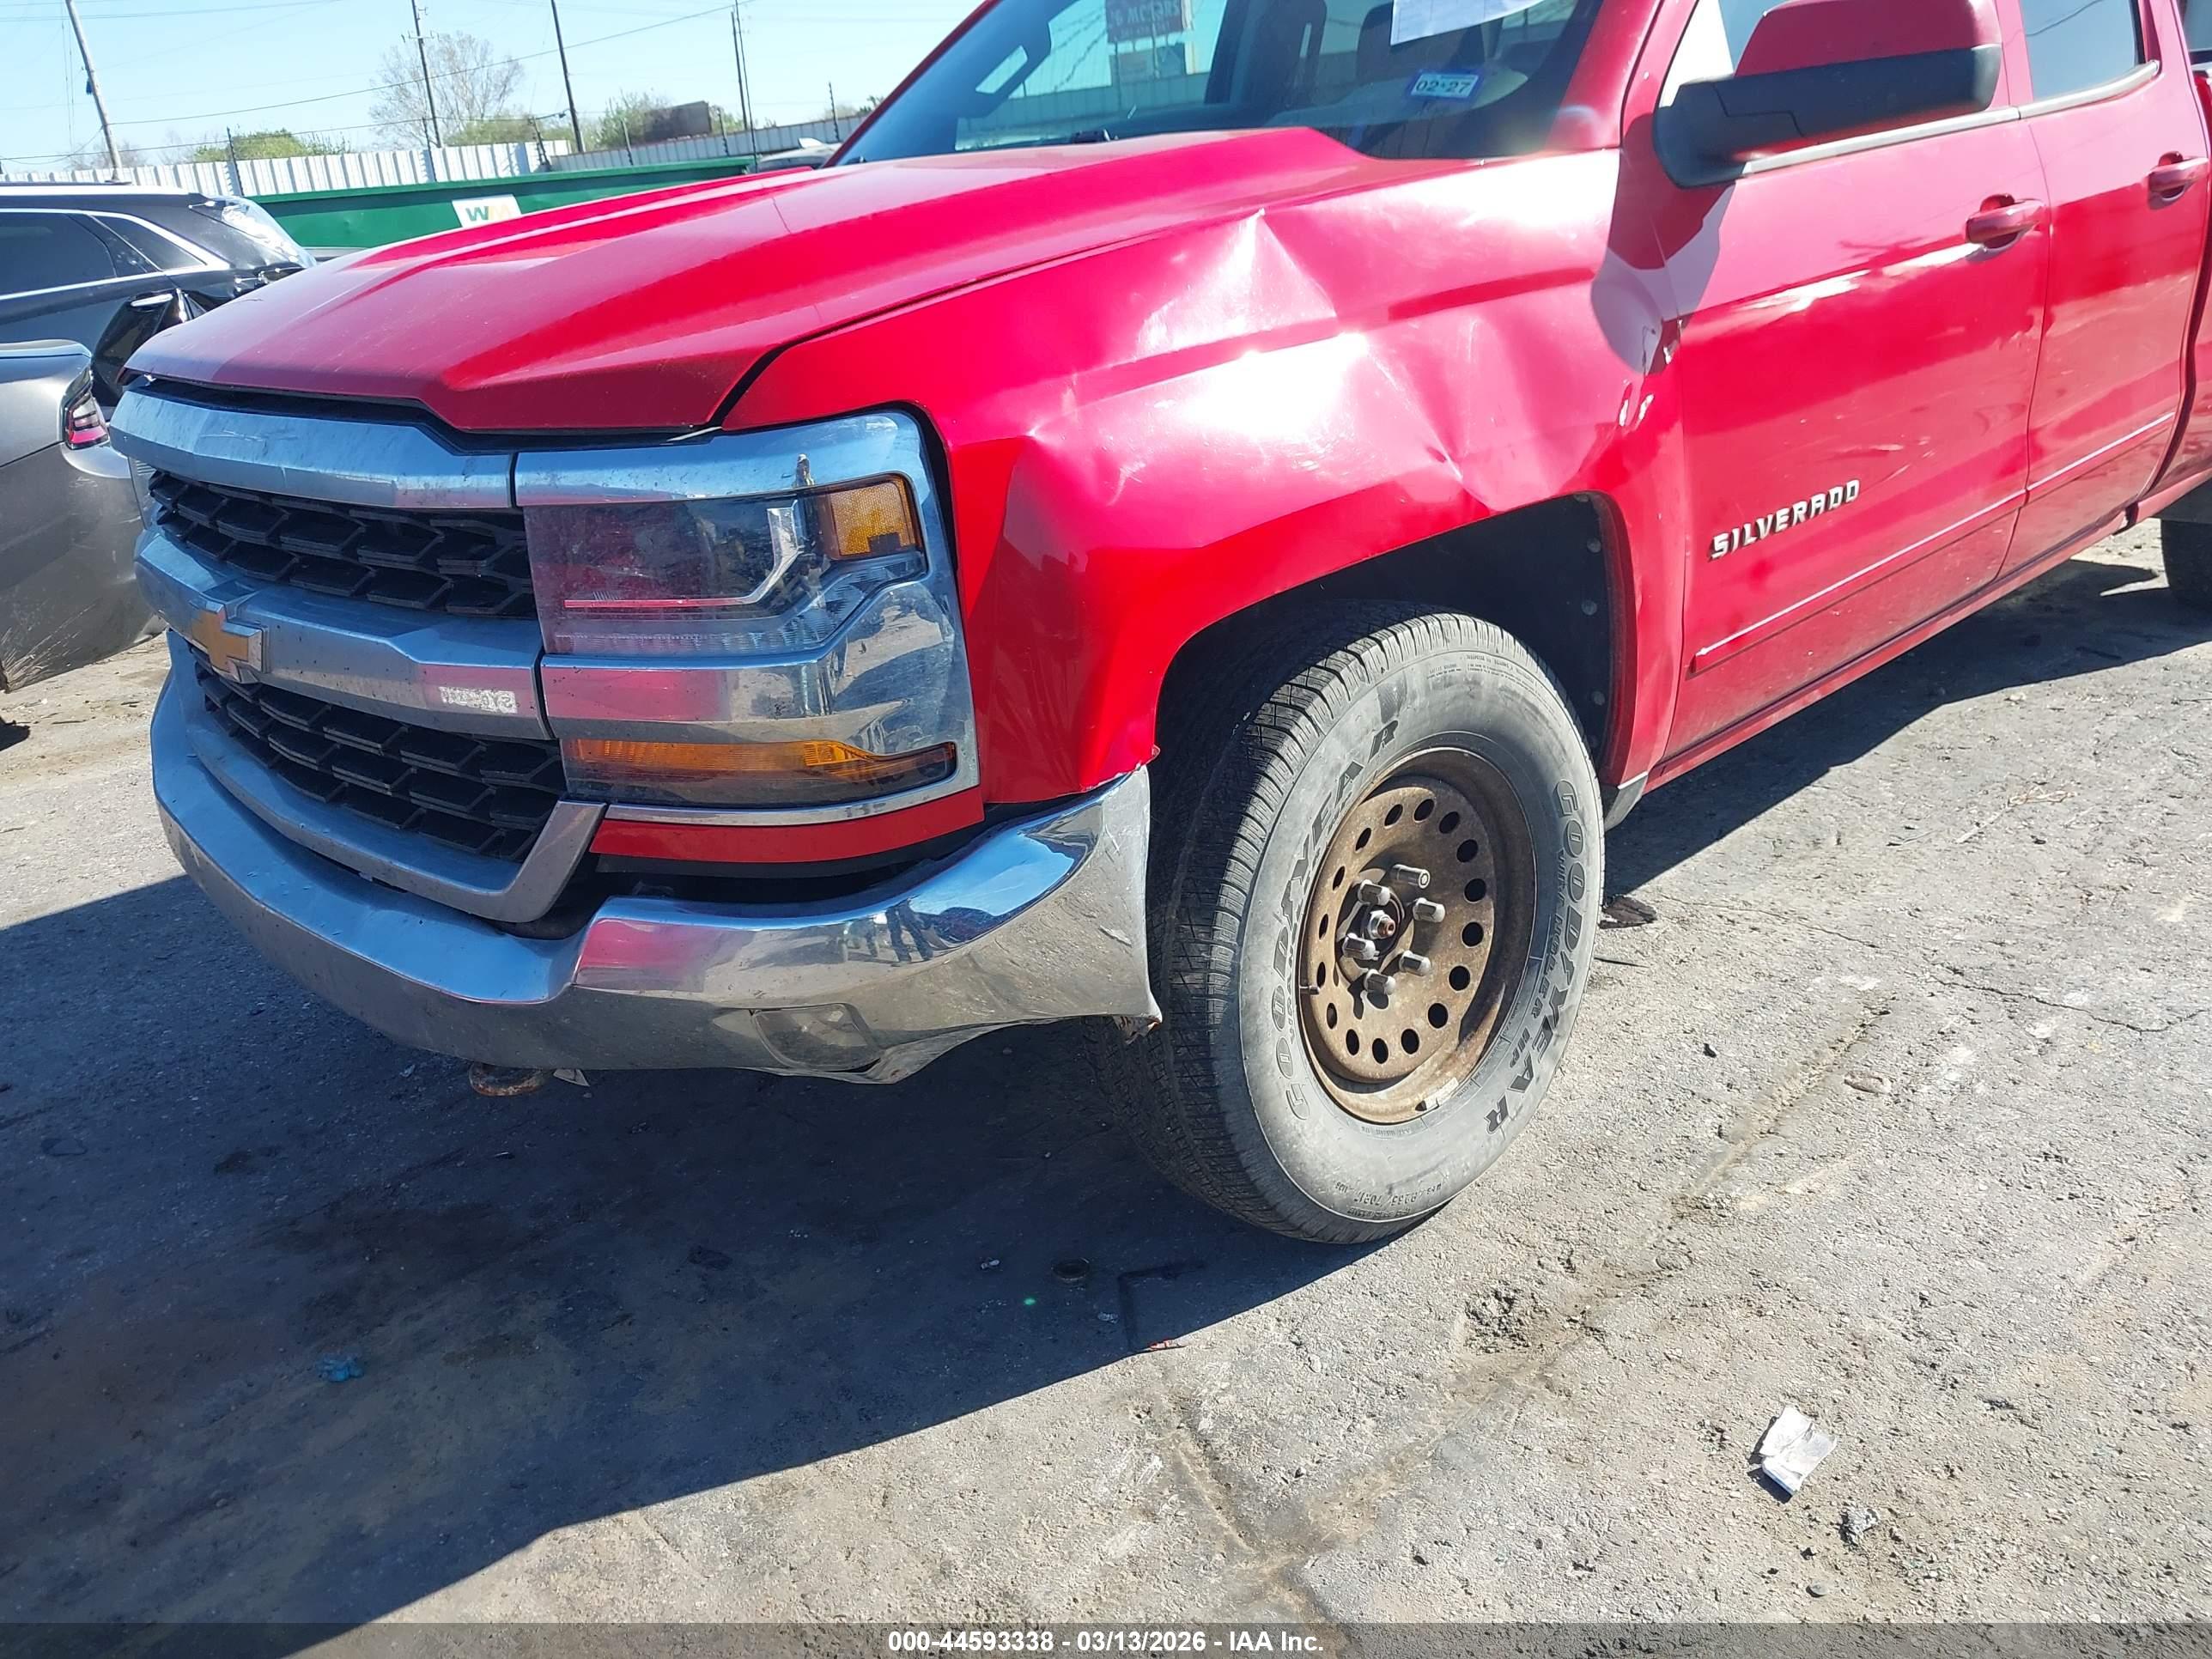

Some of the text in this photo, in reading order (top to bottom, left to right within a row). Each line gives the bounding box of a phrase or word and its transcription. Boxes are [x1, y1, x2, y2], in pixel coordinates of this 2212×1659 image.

[465, 204, 509, 222] WM
[1710, 479, 1860, 561] SILVERADO
[1272, 719, 1398, 1121] GOODYEAR
[1485, 779, 1586, 1134] GOODYEAR
